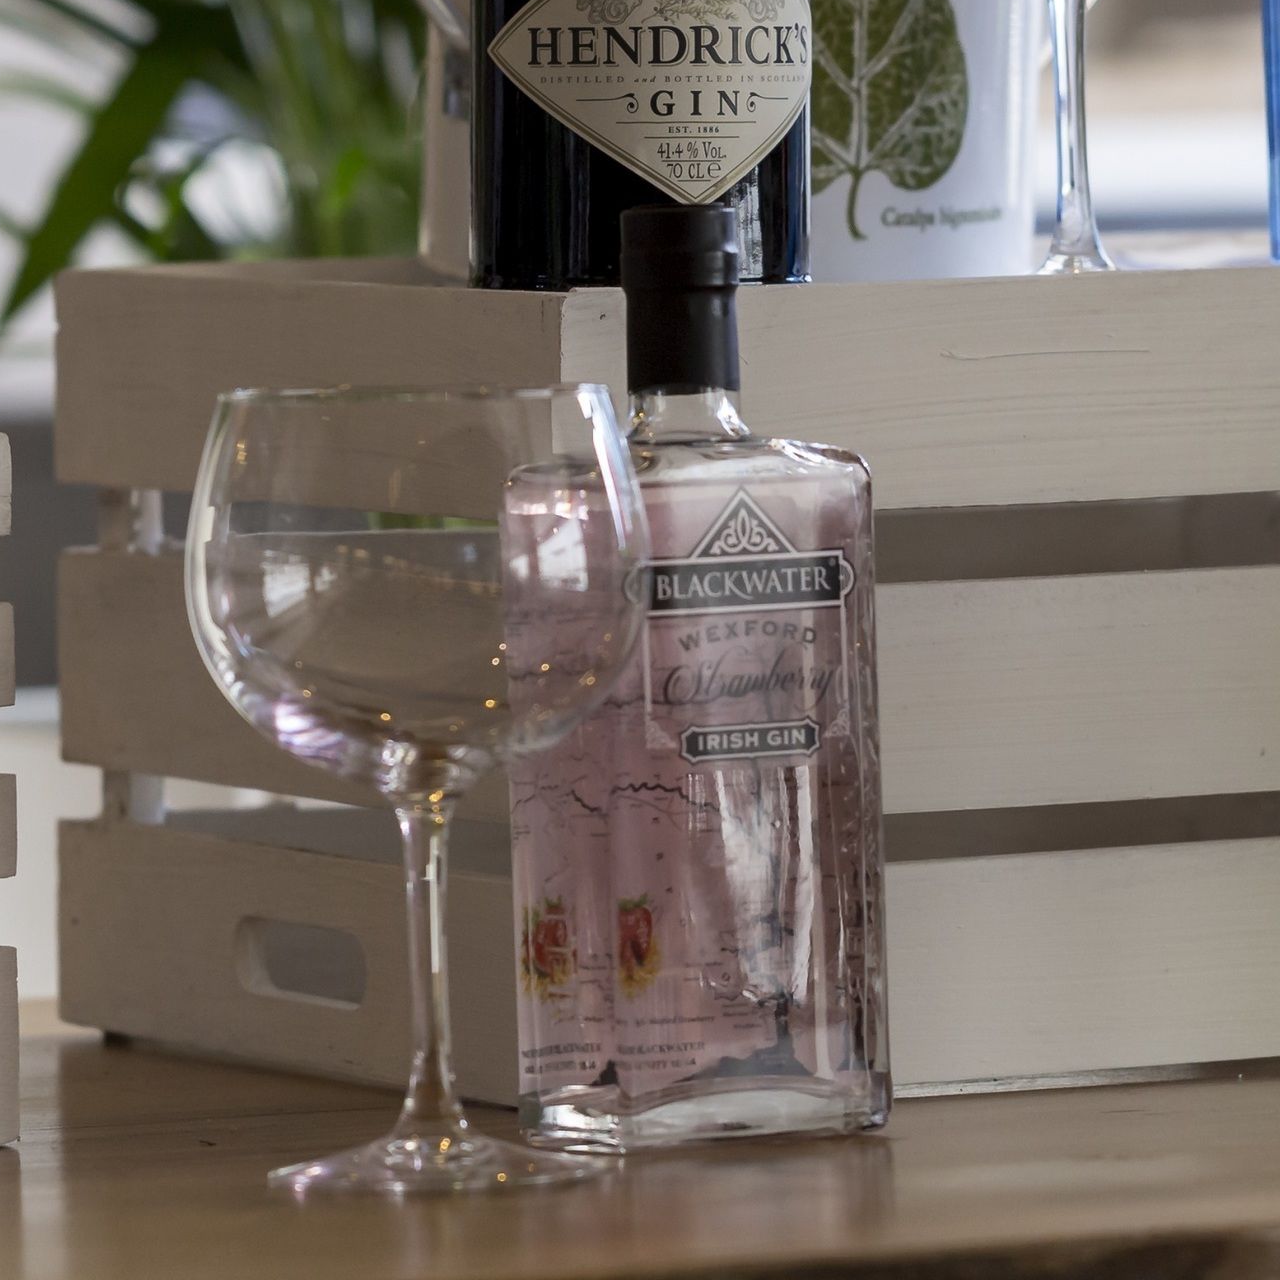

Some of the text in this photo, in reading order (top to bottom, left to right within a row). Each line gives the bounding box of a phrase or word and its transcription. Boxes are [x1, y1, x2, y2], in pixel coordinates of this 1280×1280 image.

[527, 22, 808, 67] HENDRICK'S
[540, 75, 625, 84] DISTILLED
[633, 75, 657, 83] and
[664, 75, 733, 83] BOTTLED
[740, 75, 754, 83] IN
[650, 89, 740, 117] GIN
[667, 126, 693, 134] EST.
[657, 142, 684, 159] 41.4
[666, 163, 683, 178] 70
[655, 565, 832, 601] BLACKWATER
[677, 620, 818, 653] WEXFORD
[697, 727, 807, 752] IRISH GIN
